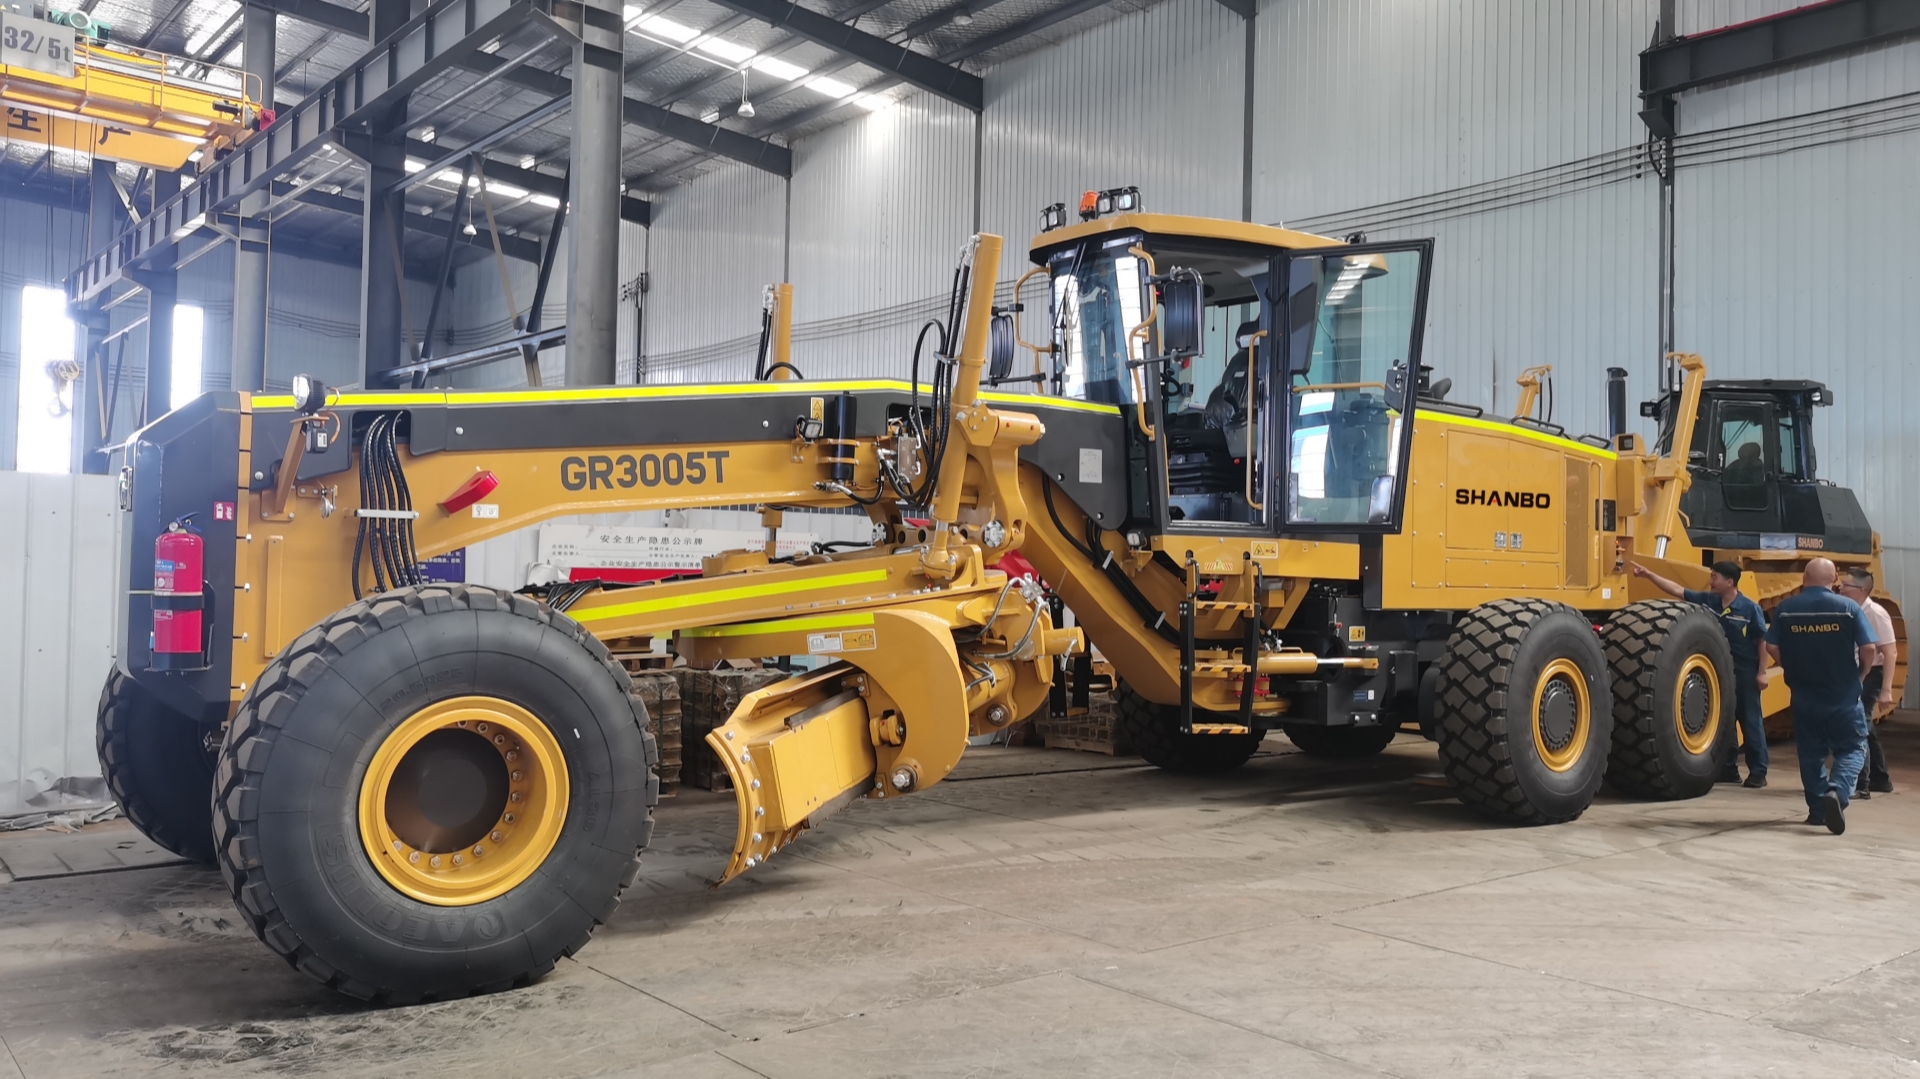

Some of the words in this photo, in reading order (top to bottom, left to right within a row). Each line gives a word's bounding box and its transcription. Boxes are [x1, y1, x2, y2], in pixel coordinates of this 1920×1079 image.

[560, 451, 730, 491] GR3005T
[1455, 488, 1551, 509] SHANBO
[599, 534, 704, 546] 安全生产隐患公示牌
[1797, 536, 1824, 549] SHANBO
[1790, 623, 1840, 633] SHANBO
[319, 833, 469, 943] AEOLUS
